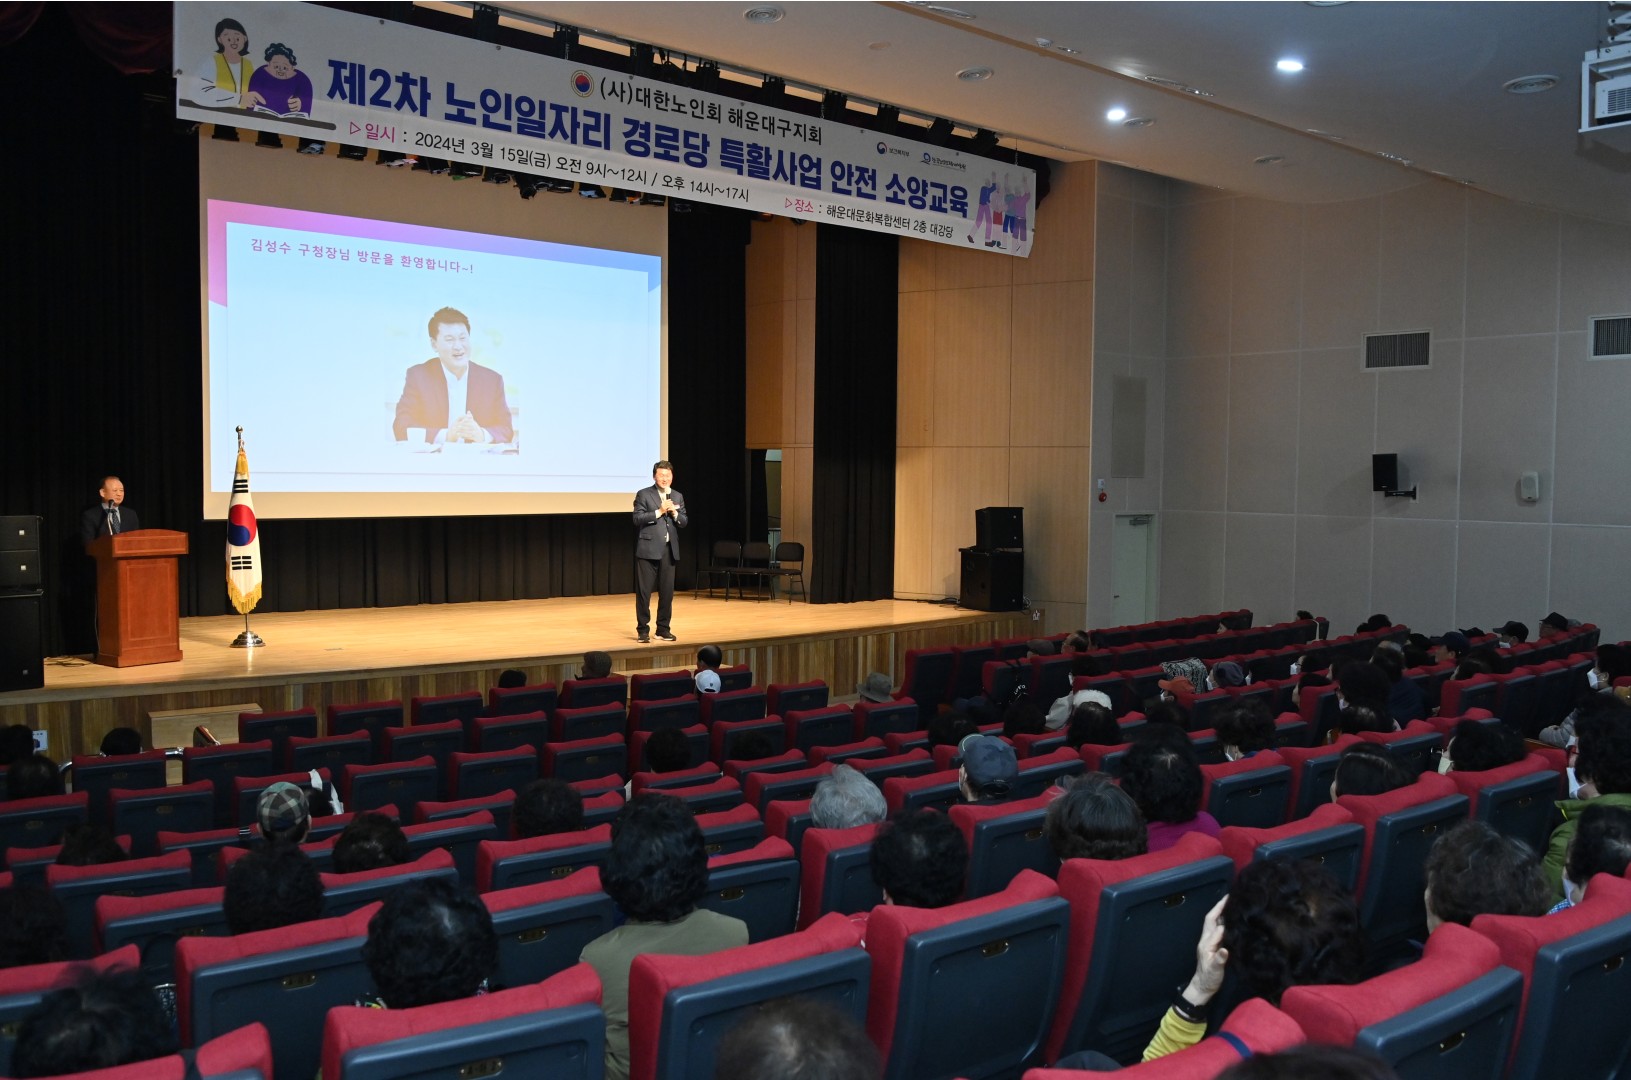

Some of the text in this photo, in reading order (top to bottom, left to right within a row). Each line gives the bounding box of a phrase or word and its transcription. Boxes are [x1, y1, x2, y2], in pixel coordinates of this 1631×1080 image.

[326, 58, 969, 219] 제2차 노인일자리 경로당 특활사업 안전 소양교육
[600, 77, 823, 146] (사)대한노인회 해운대구지회
[364, 123, 396, 144] 일시
[415, 132, 466, 156] 2024년
[471, 141, 494, 159] 3월
[500, 147, 551, 171] 15일(금)
[555, 156, 582, 175] 오전
[586, 162, 647, 186] 9시~12시
[662, 174, 686, 190] 오후
[690, 180, 750, 203] 14시~17시
[794, 198, 814, 214] 장소
[826, 204, 911, 232] 해운대문화복합센터
[914, 219, 928, 234] 2층
[929, 222, 955, 239] 대강당
[250, 238, 473, 273] 김성수 구청장님 방문을 환영합니다~!
